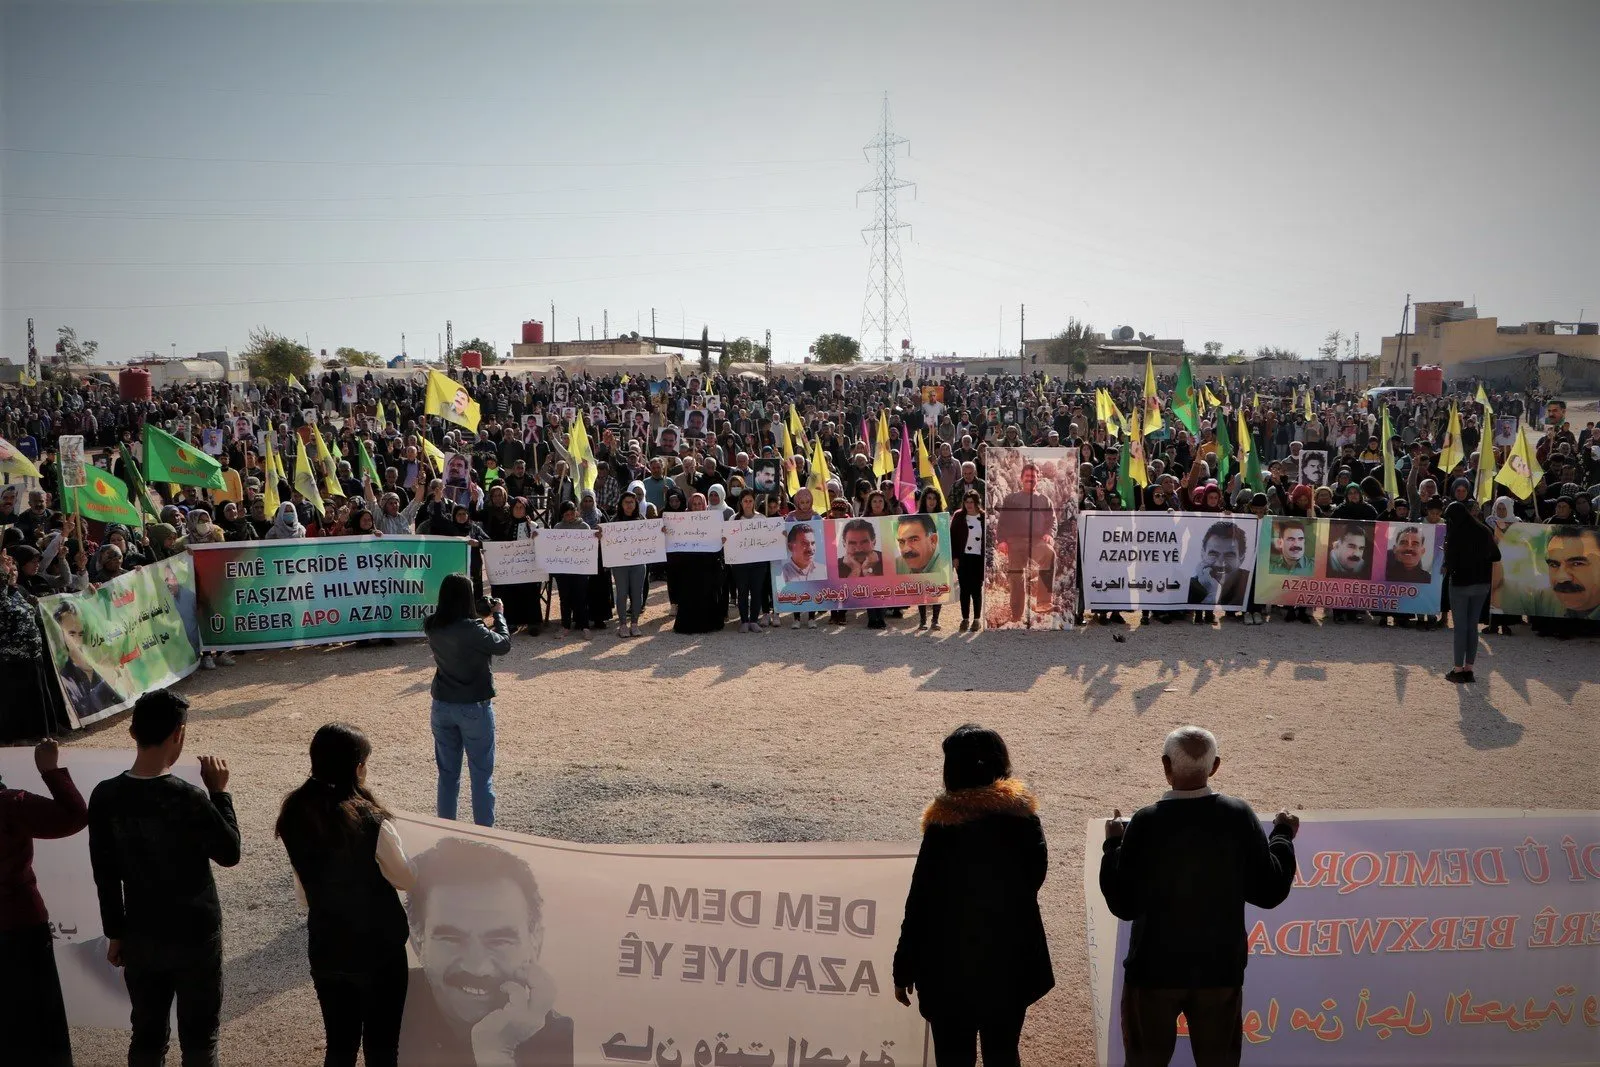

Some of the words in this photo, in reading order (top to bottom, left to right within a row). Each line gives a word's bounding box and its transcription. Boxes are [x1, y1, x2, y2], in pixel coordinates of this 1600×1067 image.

[1102, 530, 1134, 544] DEM
[1136, 530, 1178, 544] DEMA
[1099, 549, 1160, 562] AZADIYE
[1162, 547, 1180, 562] YÊ
[226, 558, 266, 578] EMÊ
[273, 553, 349, 576] TECRÎDÊ
[356, 550, 433, 573] BIŞKÎNIN
[235, 582, 315, 607] FAŞIZMÊ
[323, 576, 425, 599] HILWEŞÎNIN
[852, 584, 870, 598] الله
[1091, 576, 1125, 592] الحرية
[1127, 577, 1154, 592] وقت
[1156, 577, 1181, 593] حان
[1281, 579, 1340, 593] AZADIYA
[1343, 581, 1386, 596] RÊBER
[1388, 585, 1418, 598] APO
[1296, 594, 1355, 608] AZADIYA
[1358, 597, 1379, 609] ME
[1381, 598, 1399, 610] YE
[210, 614, 225, 633] Û
[233, 612, 293, 632] RÊBER
[300, 608, 340, 628] APO
[348, 604, 394, 622] AZAD
